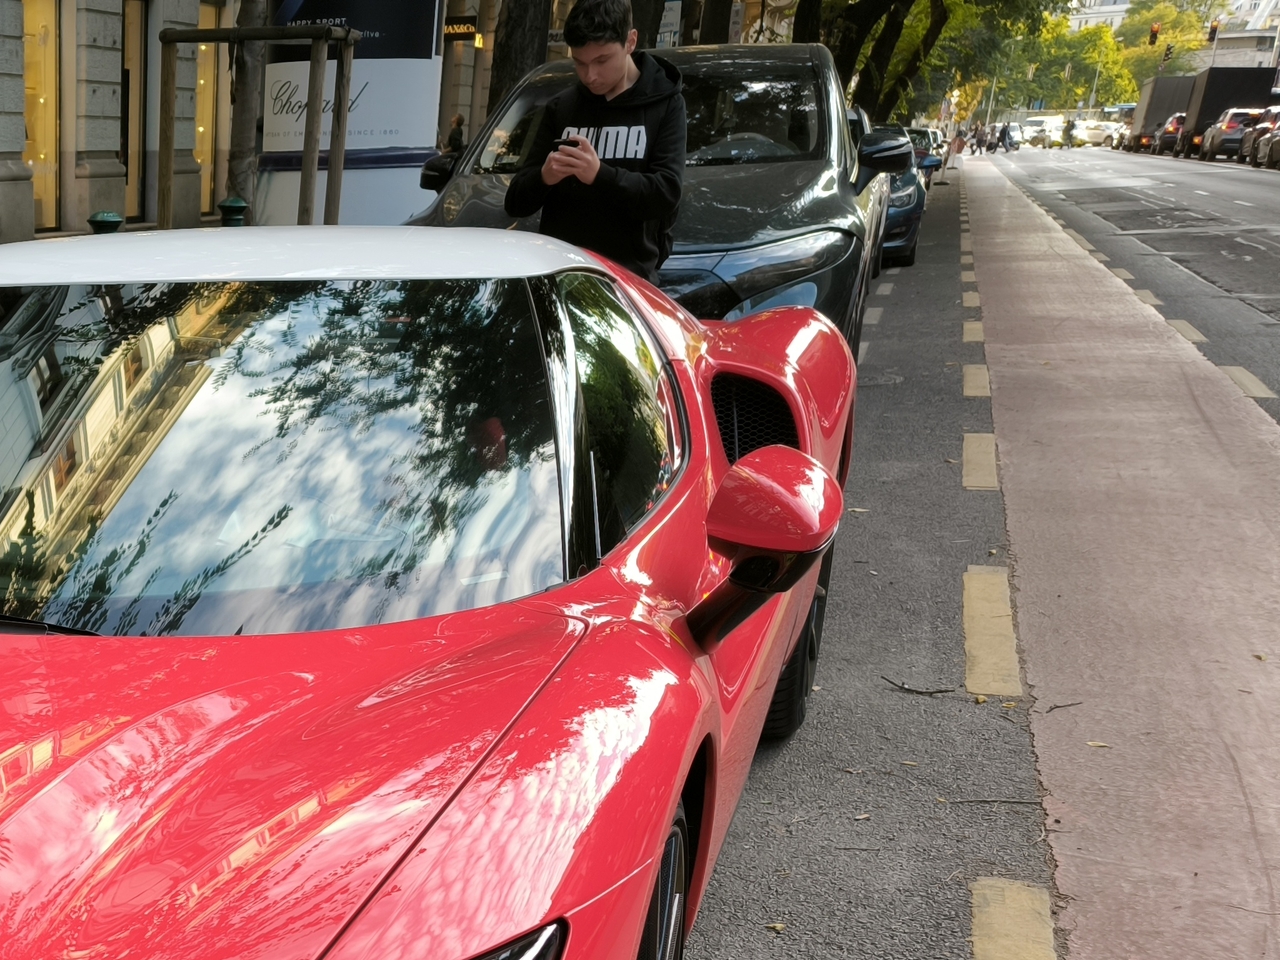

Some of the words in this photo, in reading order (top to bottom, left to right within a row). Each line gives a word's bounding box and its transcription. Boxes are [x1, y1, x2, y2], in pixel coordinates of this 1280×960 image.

[286, 19, 312, 27] HAPPY
[316, 17, 347, 27] SPORT
[347, 128, 375, 136] SINCE
